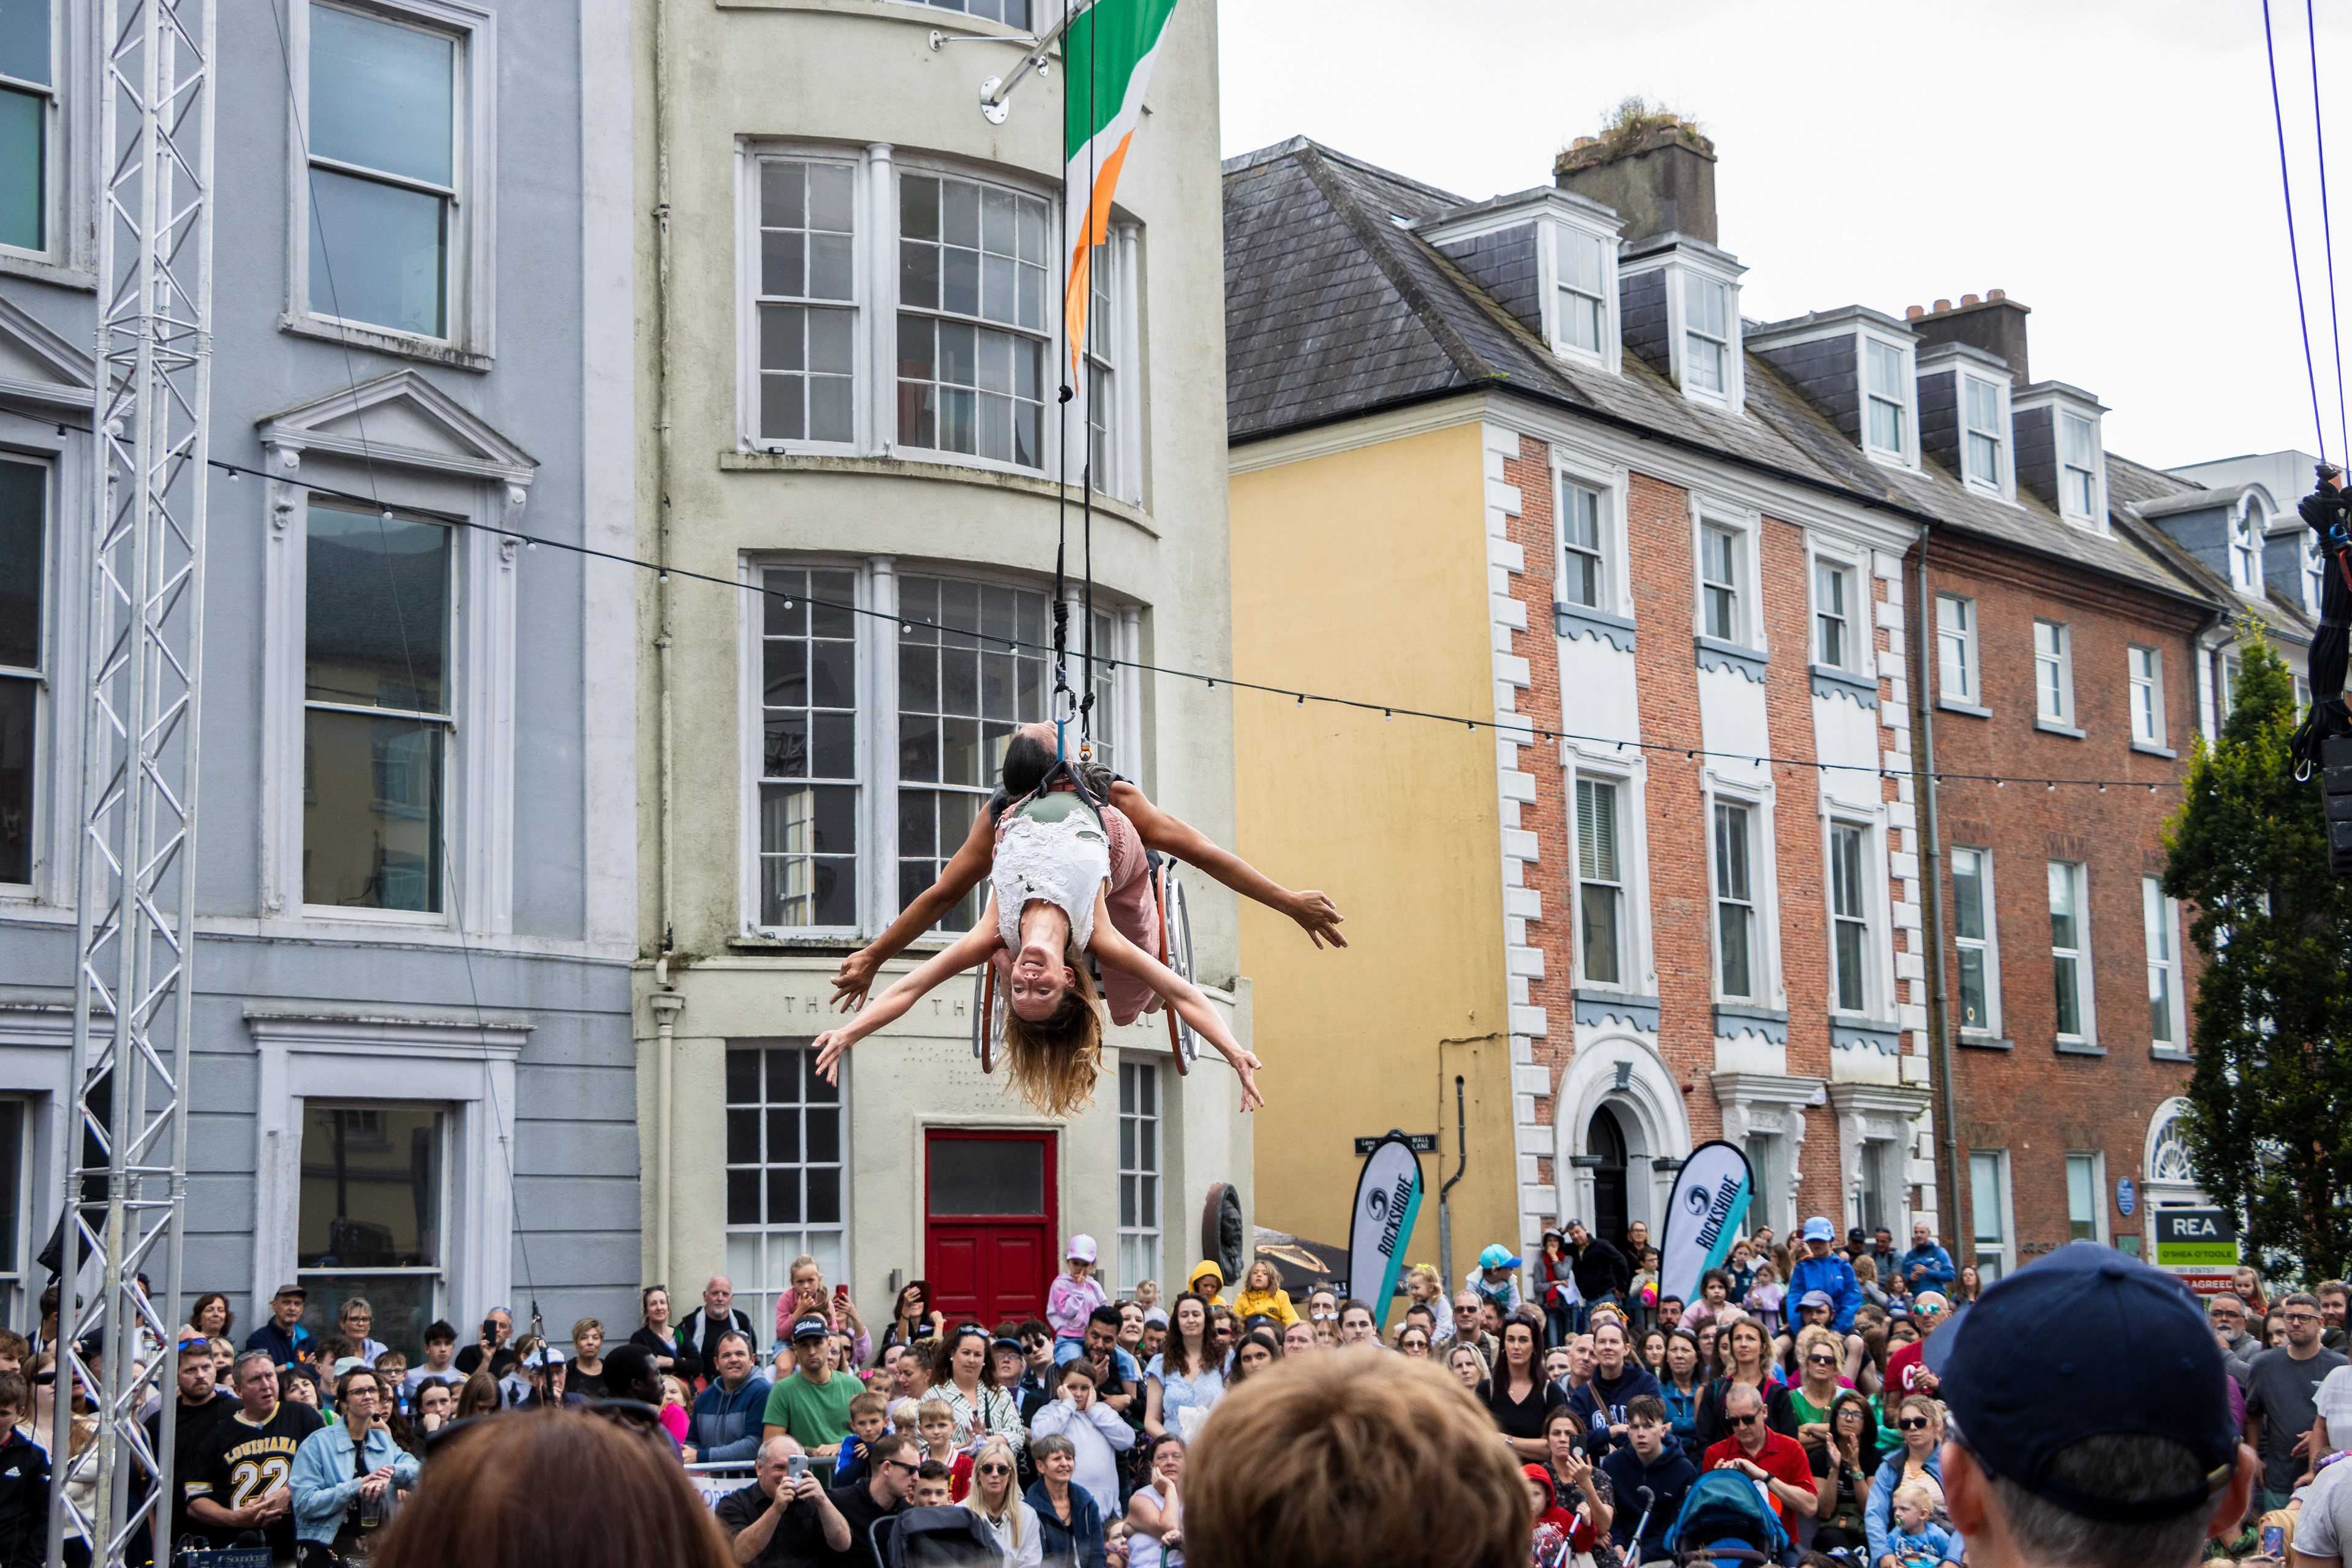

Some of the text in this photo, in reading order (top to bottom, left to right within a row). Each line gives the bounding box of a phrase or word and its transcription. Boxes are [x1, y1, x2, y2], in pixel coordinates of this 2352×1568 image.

[1378, 1172, 1414, 1259] ROCKSHORE
[1695, 1174, 1742, 1251] ROCKSHORE
[2173, 1218, 2218, 1235] REA
[2191, 1280, 2233, 1289] AGREED
[224, 1436, 296, 1465] LOUISIANA
[231, 1456, 291, 1513] 22
[227, 1553, 268, 1562] Soundcraft
